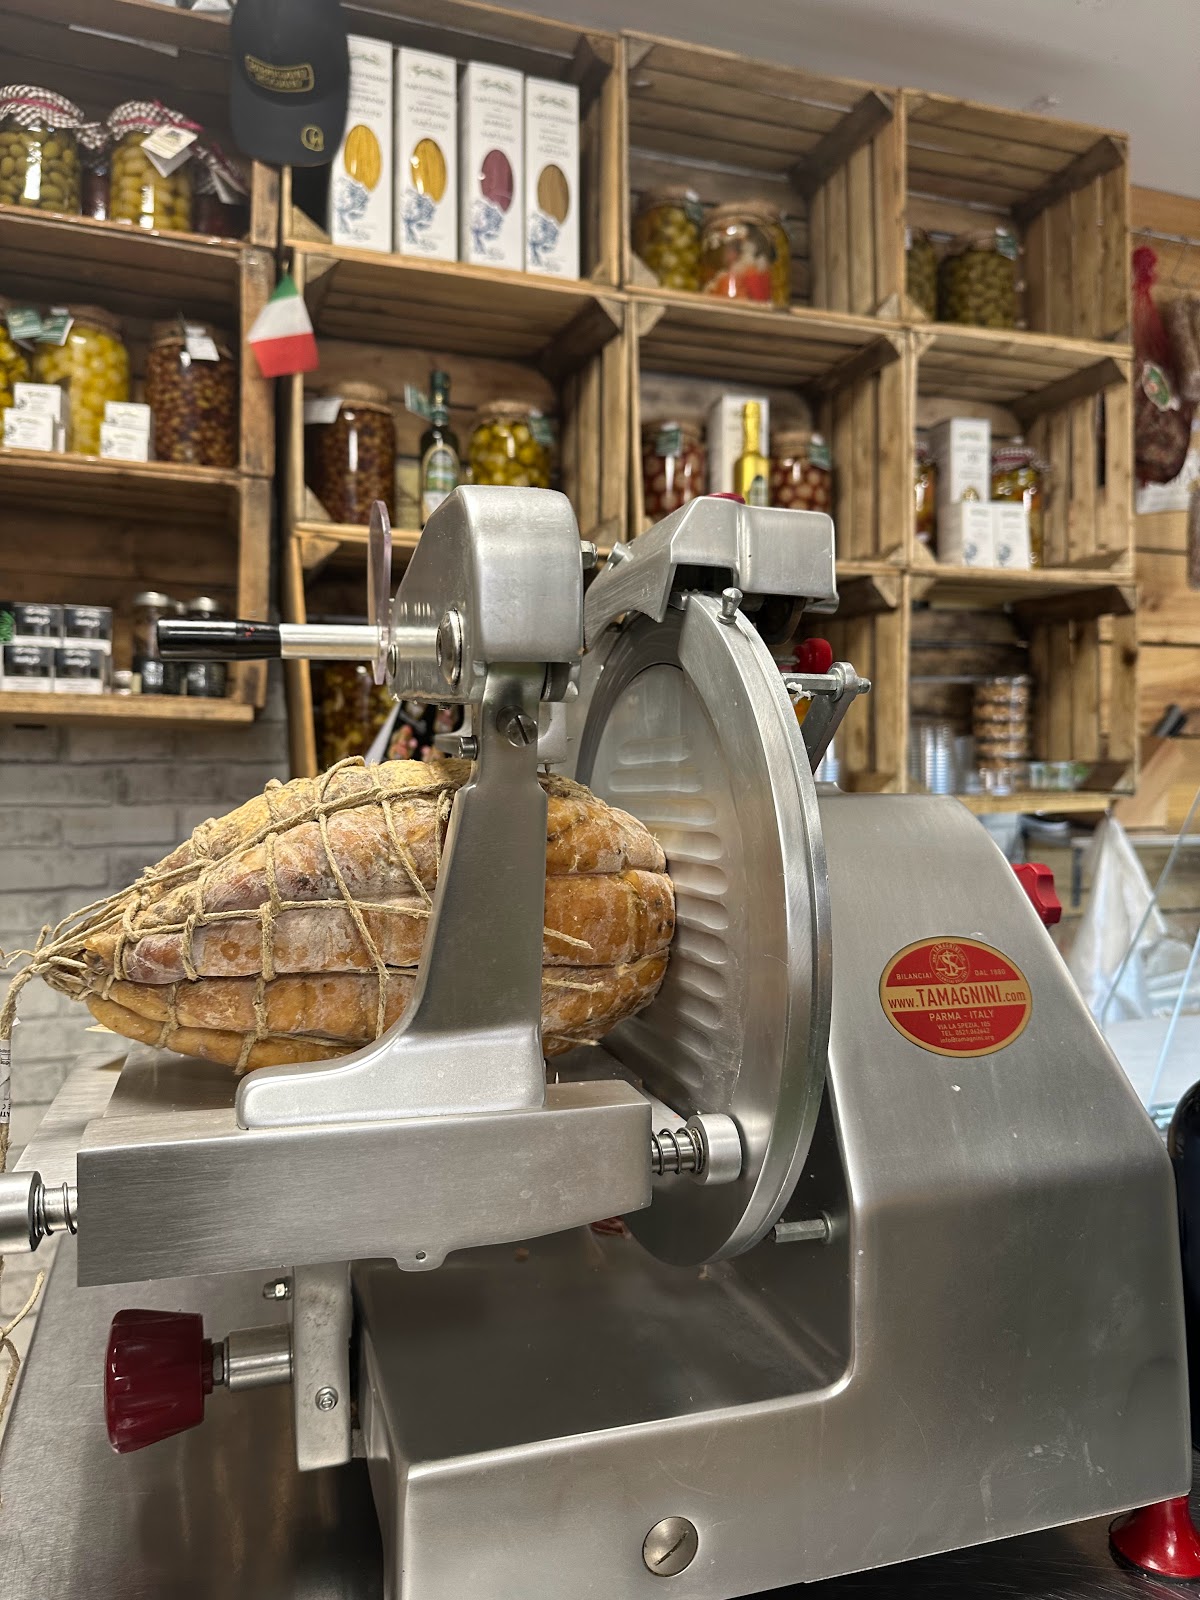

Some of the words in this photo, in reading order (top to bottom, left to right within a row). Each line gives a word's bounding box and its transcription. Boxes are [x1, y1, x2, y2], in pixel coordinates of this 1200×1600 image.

[896, 972, 933, 980] BILANCIAI
[888, 984, 1026, 1009] www.TAMAGNINI.com
[929, 1012, 961, 1021] PARMA
[969, 1010, 994, 1019] ITALY
